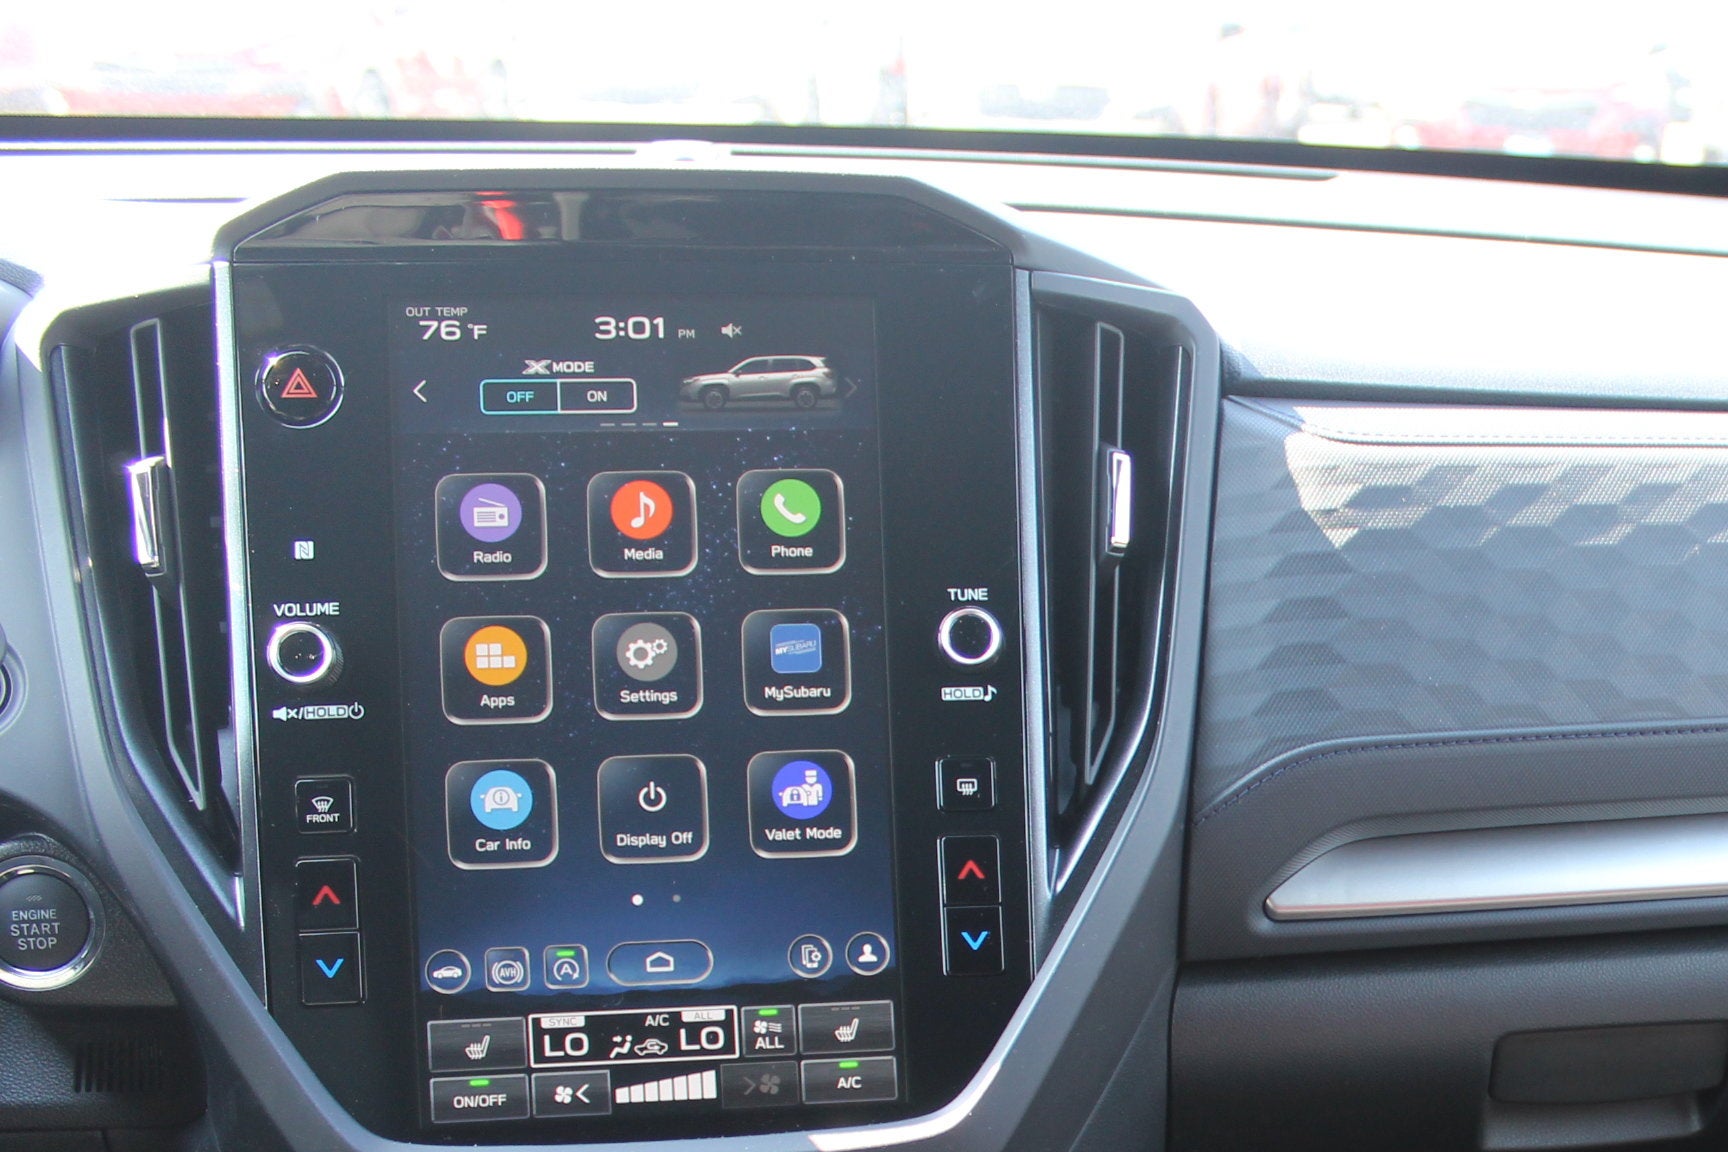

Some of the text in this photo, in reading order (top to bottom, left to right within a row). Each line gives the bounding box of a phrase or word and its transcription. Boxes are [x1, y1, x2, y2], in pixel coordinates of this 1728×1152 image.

[406, 307, 468, 316] OUT TEMP
[419, 320, 461, 340] 76
[594, 316, 695, 339] 3:01 PM
[506, 391, 607, 403] OFF ON
[473, 551, 512, 563] Radio
[624, 548, 663, 560] Media
[771, 545, 813, 557] Phone
[947, 588, 988, 601] TUNE
[274, 602, 340, 617] VOLUME
[620, 690, 677, 704] Settings
[764, 686, 830, 700] MySubaru
[944, 689, 982, 699] HOLD
[480, 694, 515, 708] Apps
[307, 814, 340, 822] FRONT
[616, 832, 692, 847] Display Off
[765, 826, 842, 841] Valet Mode
[475, 837, 531, 851] Car Info
[12, 909, 56, 920] ENGINE
[11, 923, 60, 936] START
[18, 938, 57, 950] STOP
[500, 967, 517, 978] AVH
[645, 1015, 670, 1027] A/C
[694, 1011, 714, 1019] ALL
[548, 1018, 578, 1026] SYNC
[544, 1032, 589, 1057] LO
[680, 1026, 725, 1051] LO
[755, 1037, 784, 1050] ALL
[837, 1076, 862, 1089] A/C
[453, 1094, 506, 1108] ON/OFF
